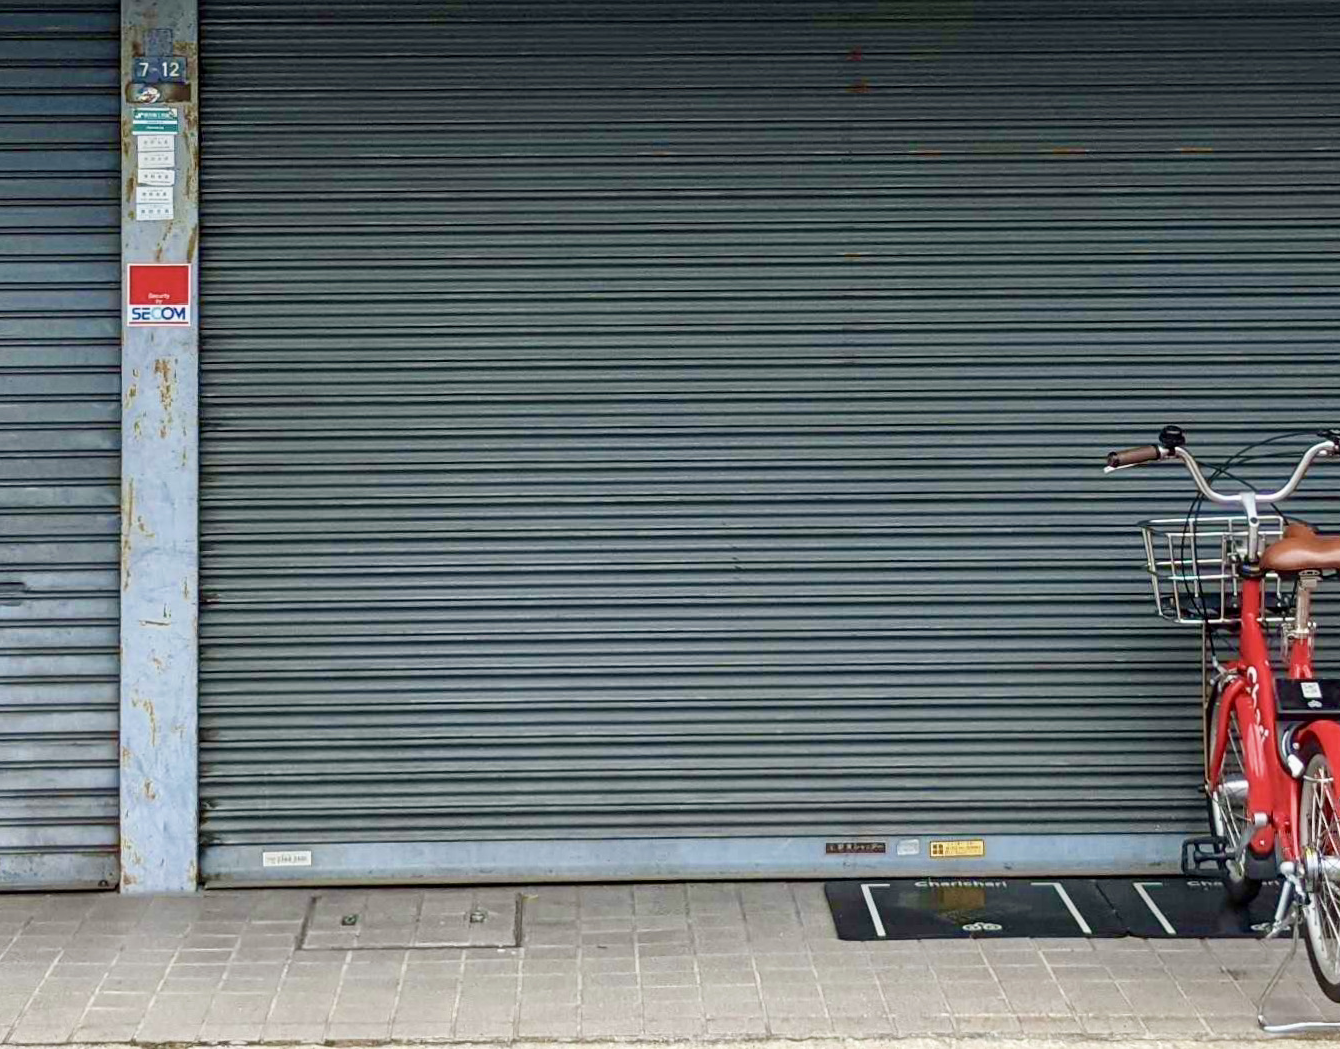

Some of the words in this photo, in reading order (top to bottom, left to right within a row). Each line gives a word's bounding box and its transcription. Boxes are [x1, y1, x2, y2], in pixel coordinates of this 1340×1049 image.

[139, 61, 180, 77] 7-12
[132, 306, 186, 320] SECOM
[914, 878, 1007, 888] Charichari
